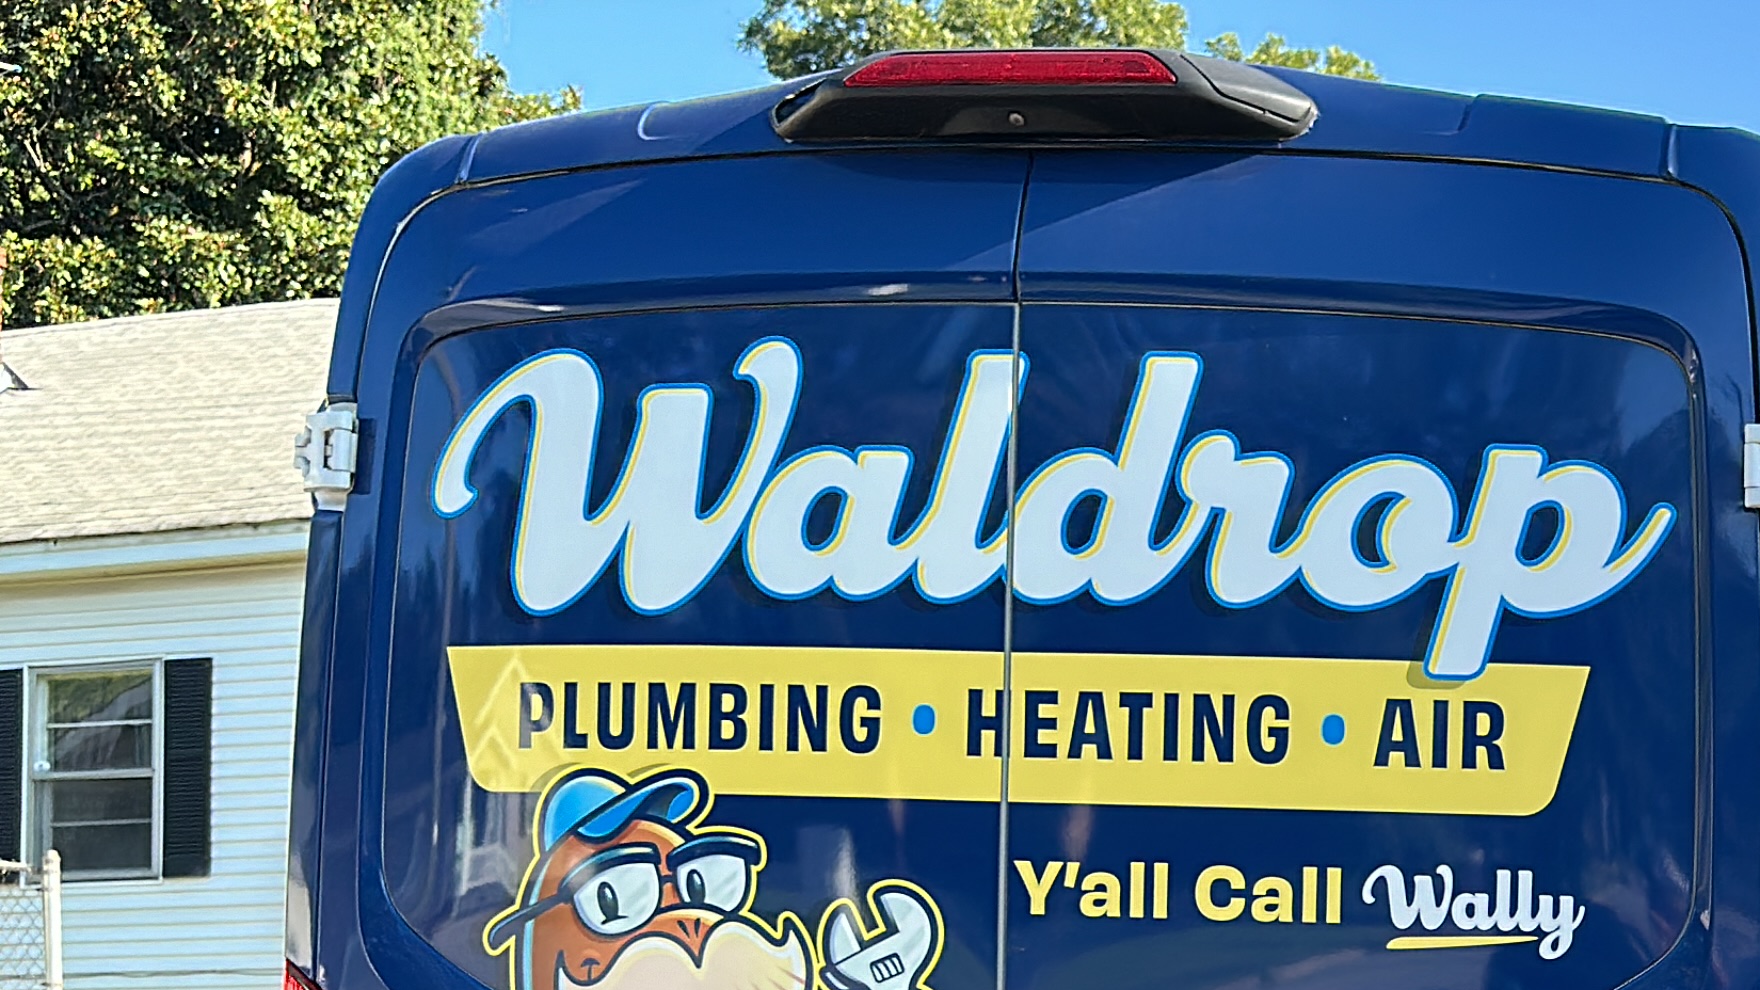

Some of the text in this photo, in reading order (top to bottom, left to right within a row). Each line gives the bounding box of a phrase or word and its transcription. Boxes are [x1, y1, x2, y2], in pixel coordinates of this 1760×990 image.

[432, 335, 1677, 682] Waldrop
[518, 681, 1506, 771] PLUMBING HEATING AIR
[1013, 859, 1587, 961] Y'all Call Wally
